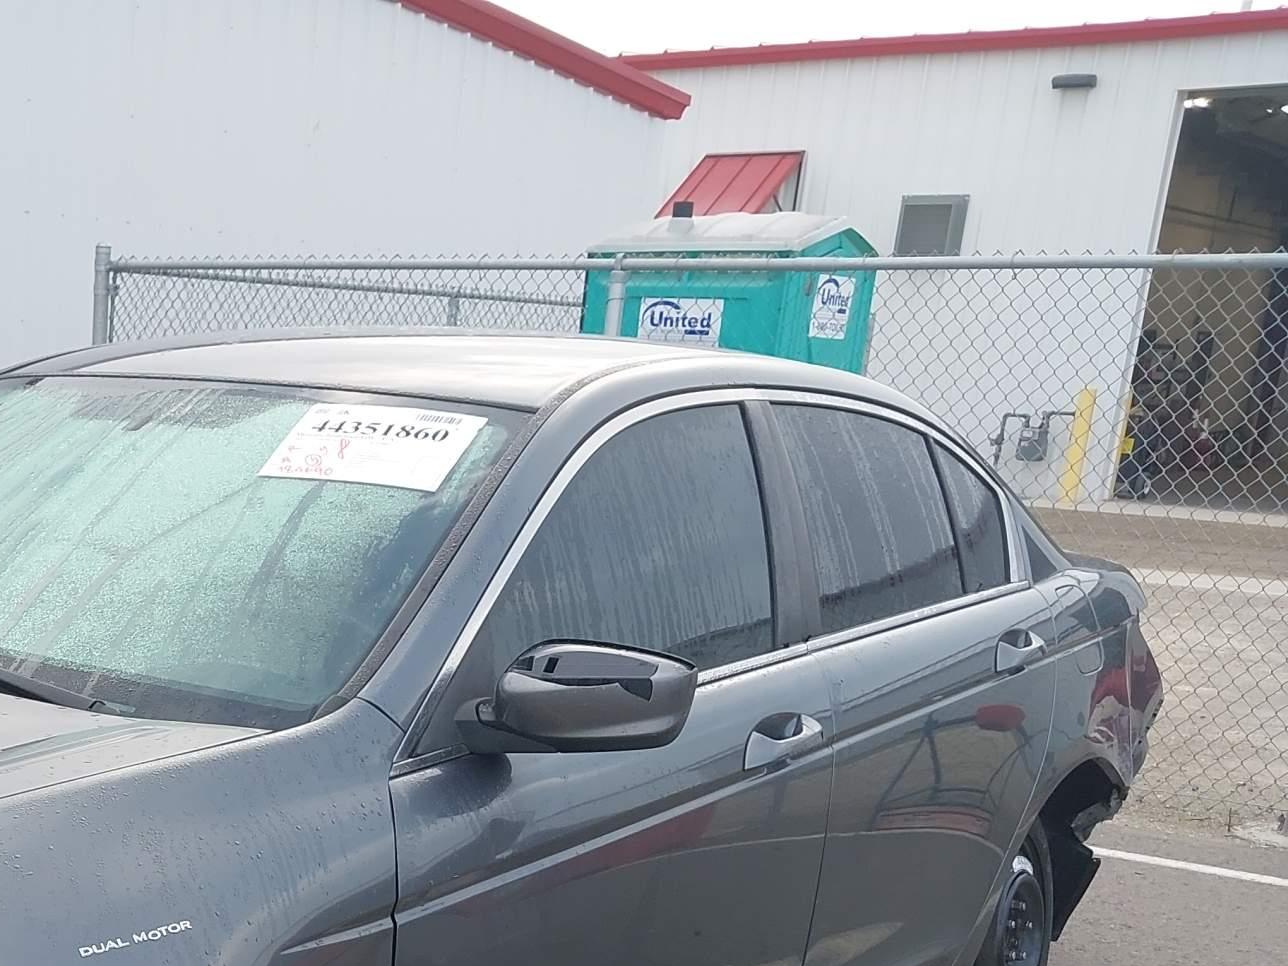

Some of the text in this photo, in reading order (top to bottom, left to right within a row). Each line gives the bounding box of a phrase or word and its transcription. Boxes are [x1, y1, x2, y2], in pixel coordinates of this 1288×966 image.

[649, 310, 712, 328] United
[312, 419, 449, 442] 44351860
[78, 920, 192, 958] DUAL MOTOR
